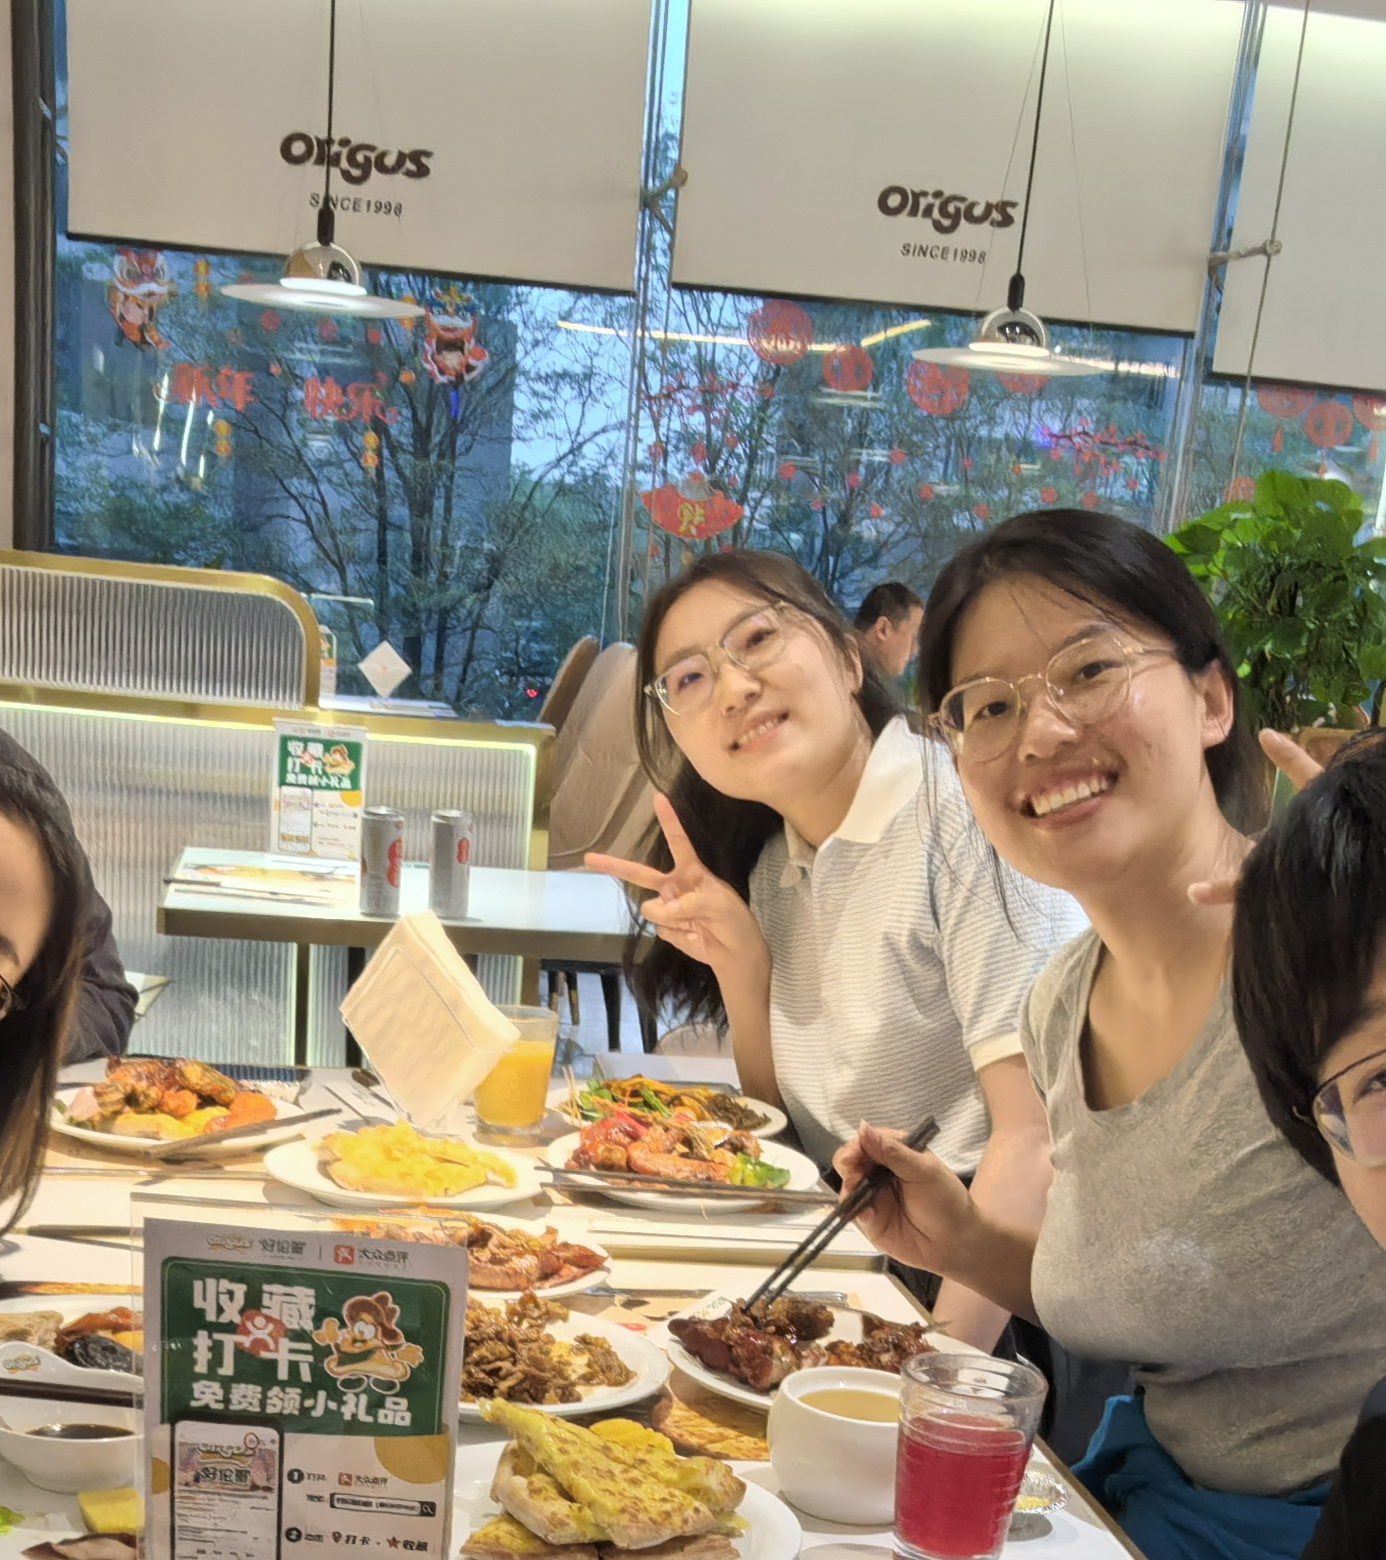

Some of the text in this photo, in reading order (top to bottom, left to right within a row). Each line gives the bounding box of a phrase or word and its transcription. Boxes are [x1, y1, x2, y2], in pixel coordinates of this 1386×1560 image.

[309, 192, 403, 217] SNCE1998
[193, 1278, 316, 1331] 收藏
[193, 1330, 314, 1383] 打卡
[190, 1380, 412, 1427] 免费领小礼品
